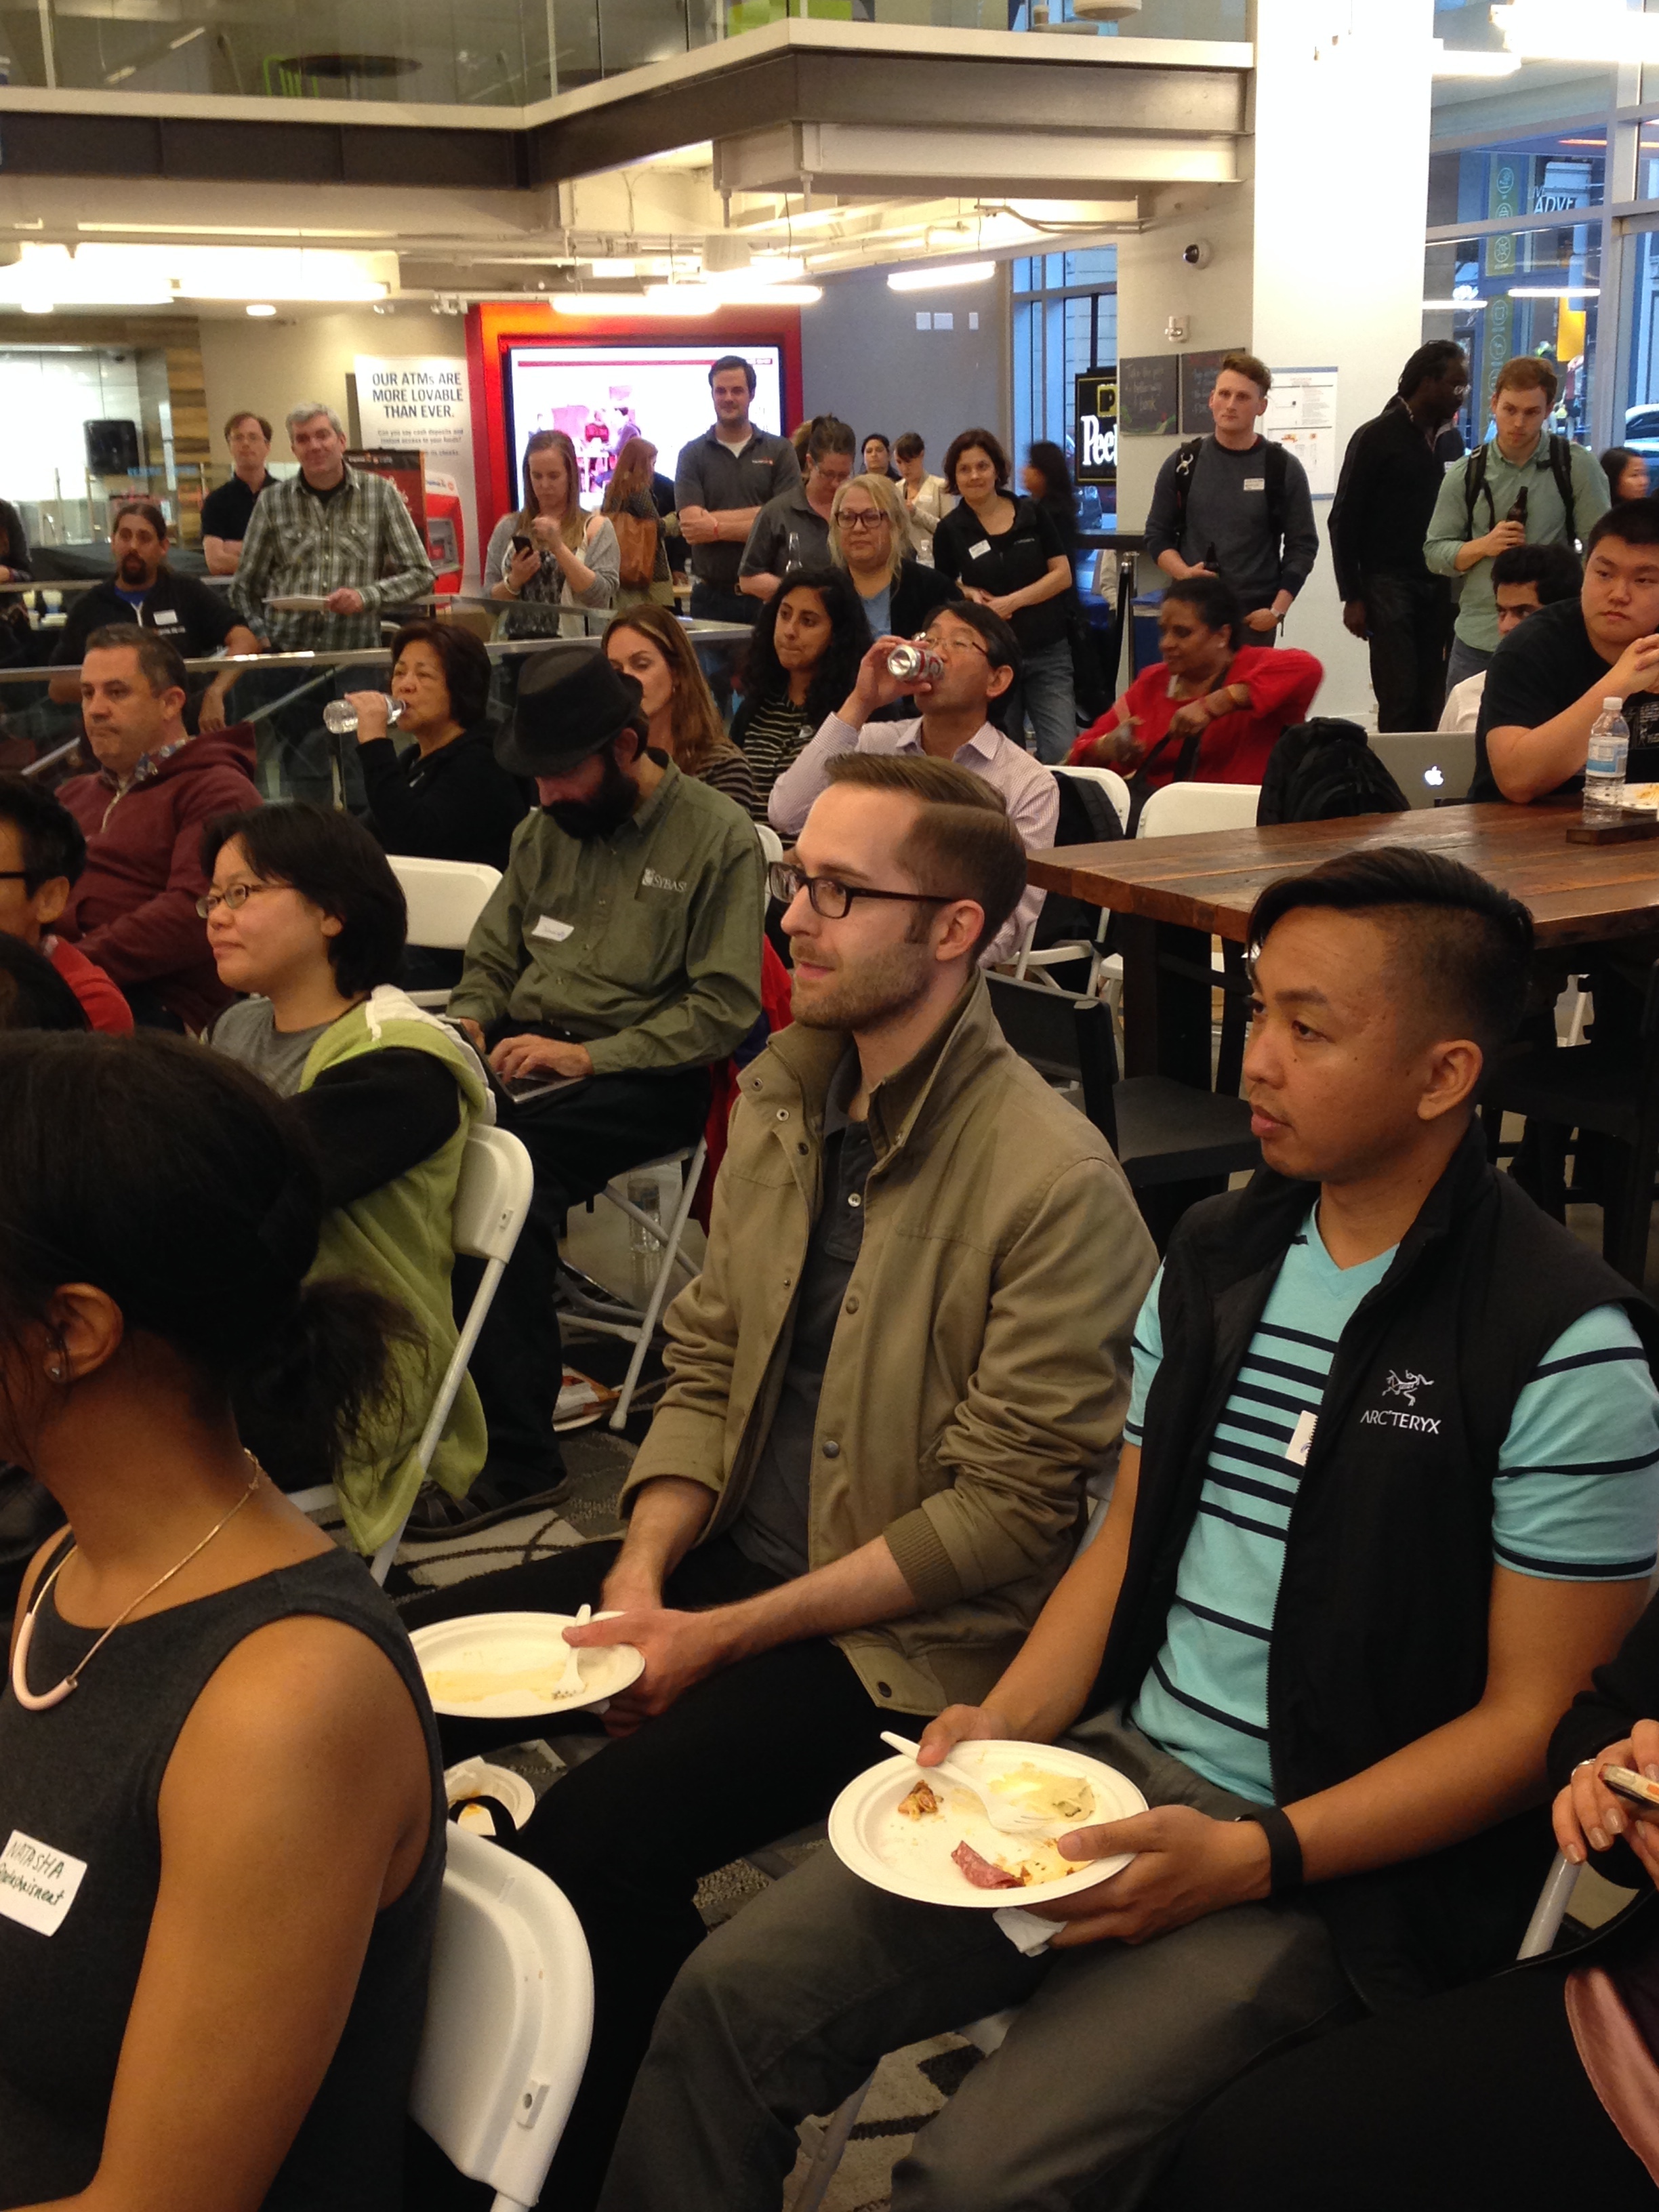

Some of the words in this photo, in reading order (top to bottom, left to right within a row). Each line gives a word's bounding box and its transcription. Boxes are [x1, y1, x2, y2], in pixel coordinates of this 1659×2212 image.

[373, 373, 398, 386] OUR
[401, 372, 434, 386] ATMs
[438, 372, 462, 385] ARE
[373, 388, 407, 403] MORE
[411, 388, 464, 402] LOVABLE
[384, 405, 417, 418] THAN
[421, 405, 455, 418] EVER.
[6, 1840, 65, 1880] NATASHA
